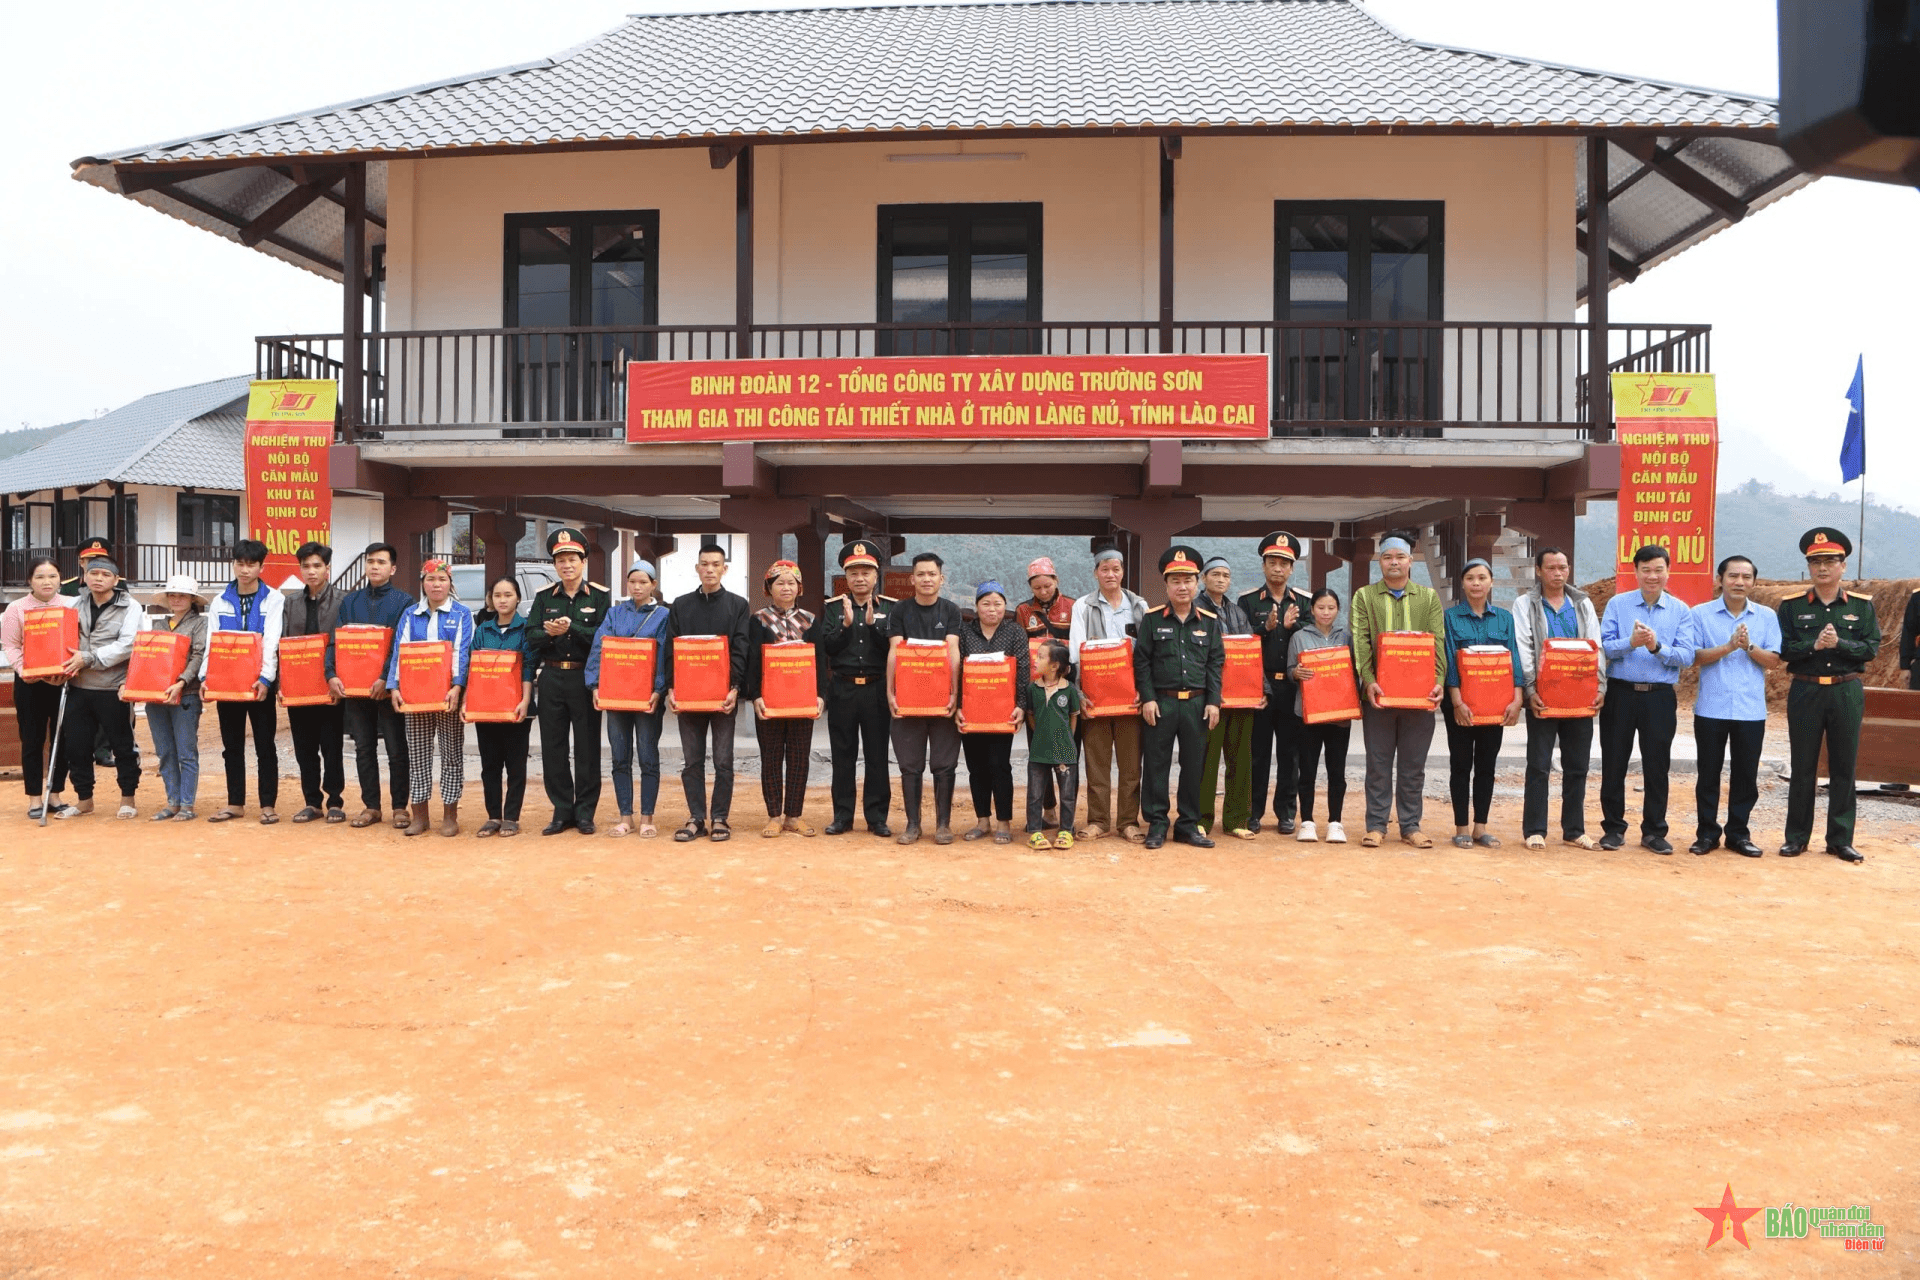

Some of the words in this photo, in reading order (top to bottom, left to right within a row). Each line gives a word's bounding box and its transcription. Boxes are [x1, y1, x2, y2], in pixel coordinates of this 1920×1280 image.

[691, 376, 734, 395] BINH
[740, 371, 791, 394] ĐOÀN
[798, 375, 819, 393] 12
[839, 366, 887, 393] TỔNG
[894, 369, 945, 392] CÔNG
[952, 373, 972, 391] TY
[979, 369, 1015, 391] XÂY
[1022, 370, 1074, 395] DỰNG
[1080, 367, 1156, 391] TRƯỜNG
[1163, 370, 1202, 391] SƠN
[641, 409, 692, 428] THAM
[699, 409, 728, 428] GIA
[734, 408, 762, 427] THI
[769, 404, 819, 426] CÔNG
[825, 403, 853, 426] TÁI
[860, 401, 910, 425] THIẾT
[916, 402, 955, 425] NHÀ
[962, 400, 974, 425] Ở
[980, 402, 1029, 425] THÔN
[1036, 402, 1085, 425] LÀNG
[1092, 399, 1124, 426] NỦ,
[1130, 399, 1174, 424] TỈNH
[1181, 401, 1216, 424] LÀO
[1223, 405, 1254, 424] CAI
[252, 434, 300, 448] NGHIỆM
[303, 436, 326, 446] THU
[1622, 432, 1679, 447] NGHIỆM
[1683, 433, 1710, 445] THU
[268, 452, 289, 466] NỘI
[294, 452, 309, 466] BỘ
[1642, 451, 1666, 466] NỘI
[1671, 451, 1689, 467] BỘ
[262, 470, 286, 481] CĂN
[1632, 470, 1661, 483] CĂN
[267, 489, 291, 499] KHU
[296, 488, 314, 500] TÁI
[1636, 492, 1665, 502] KHU
[1669, 490, 1690, 503] TÁI
[267, 507, 296, 519] ĐỊNH
[301, 507, 317, 517] CƯ
[1634, 511, 1668, 524] ĐỊNH
[1673, 510, 1692, 522] CƯ
[1677, 527, 1704, 563] NỦ
